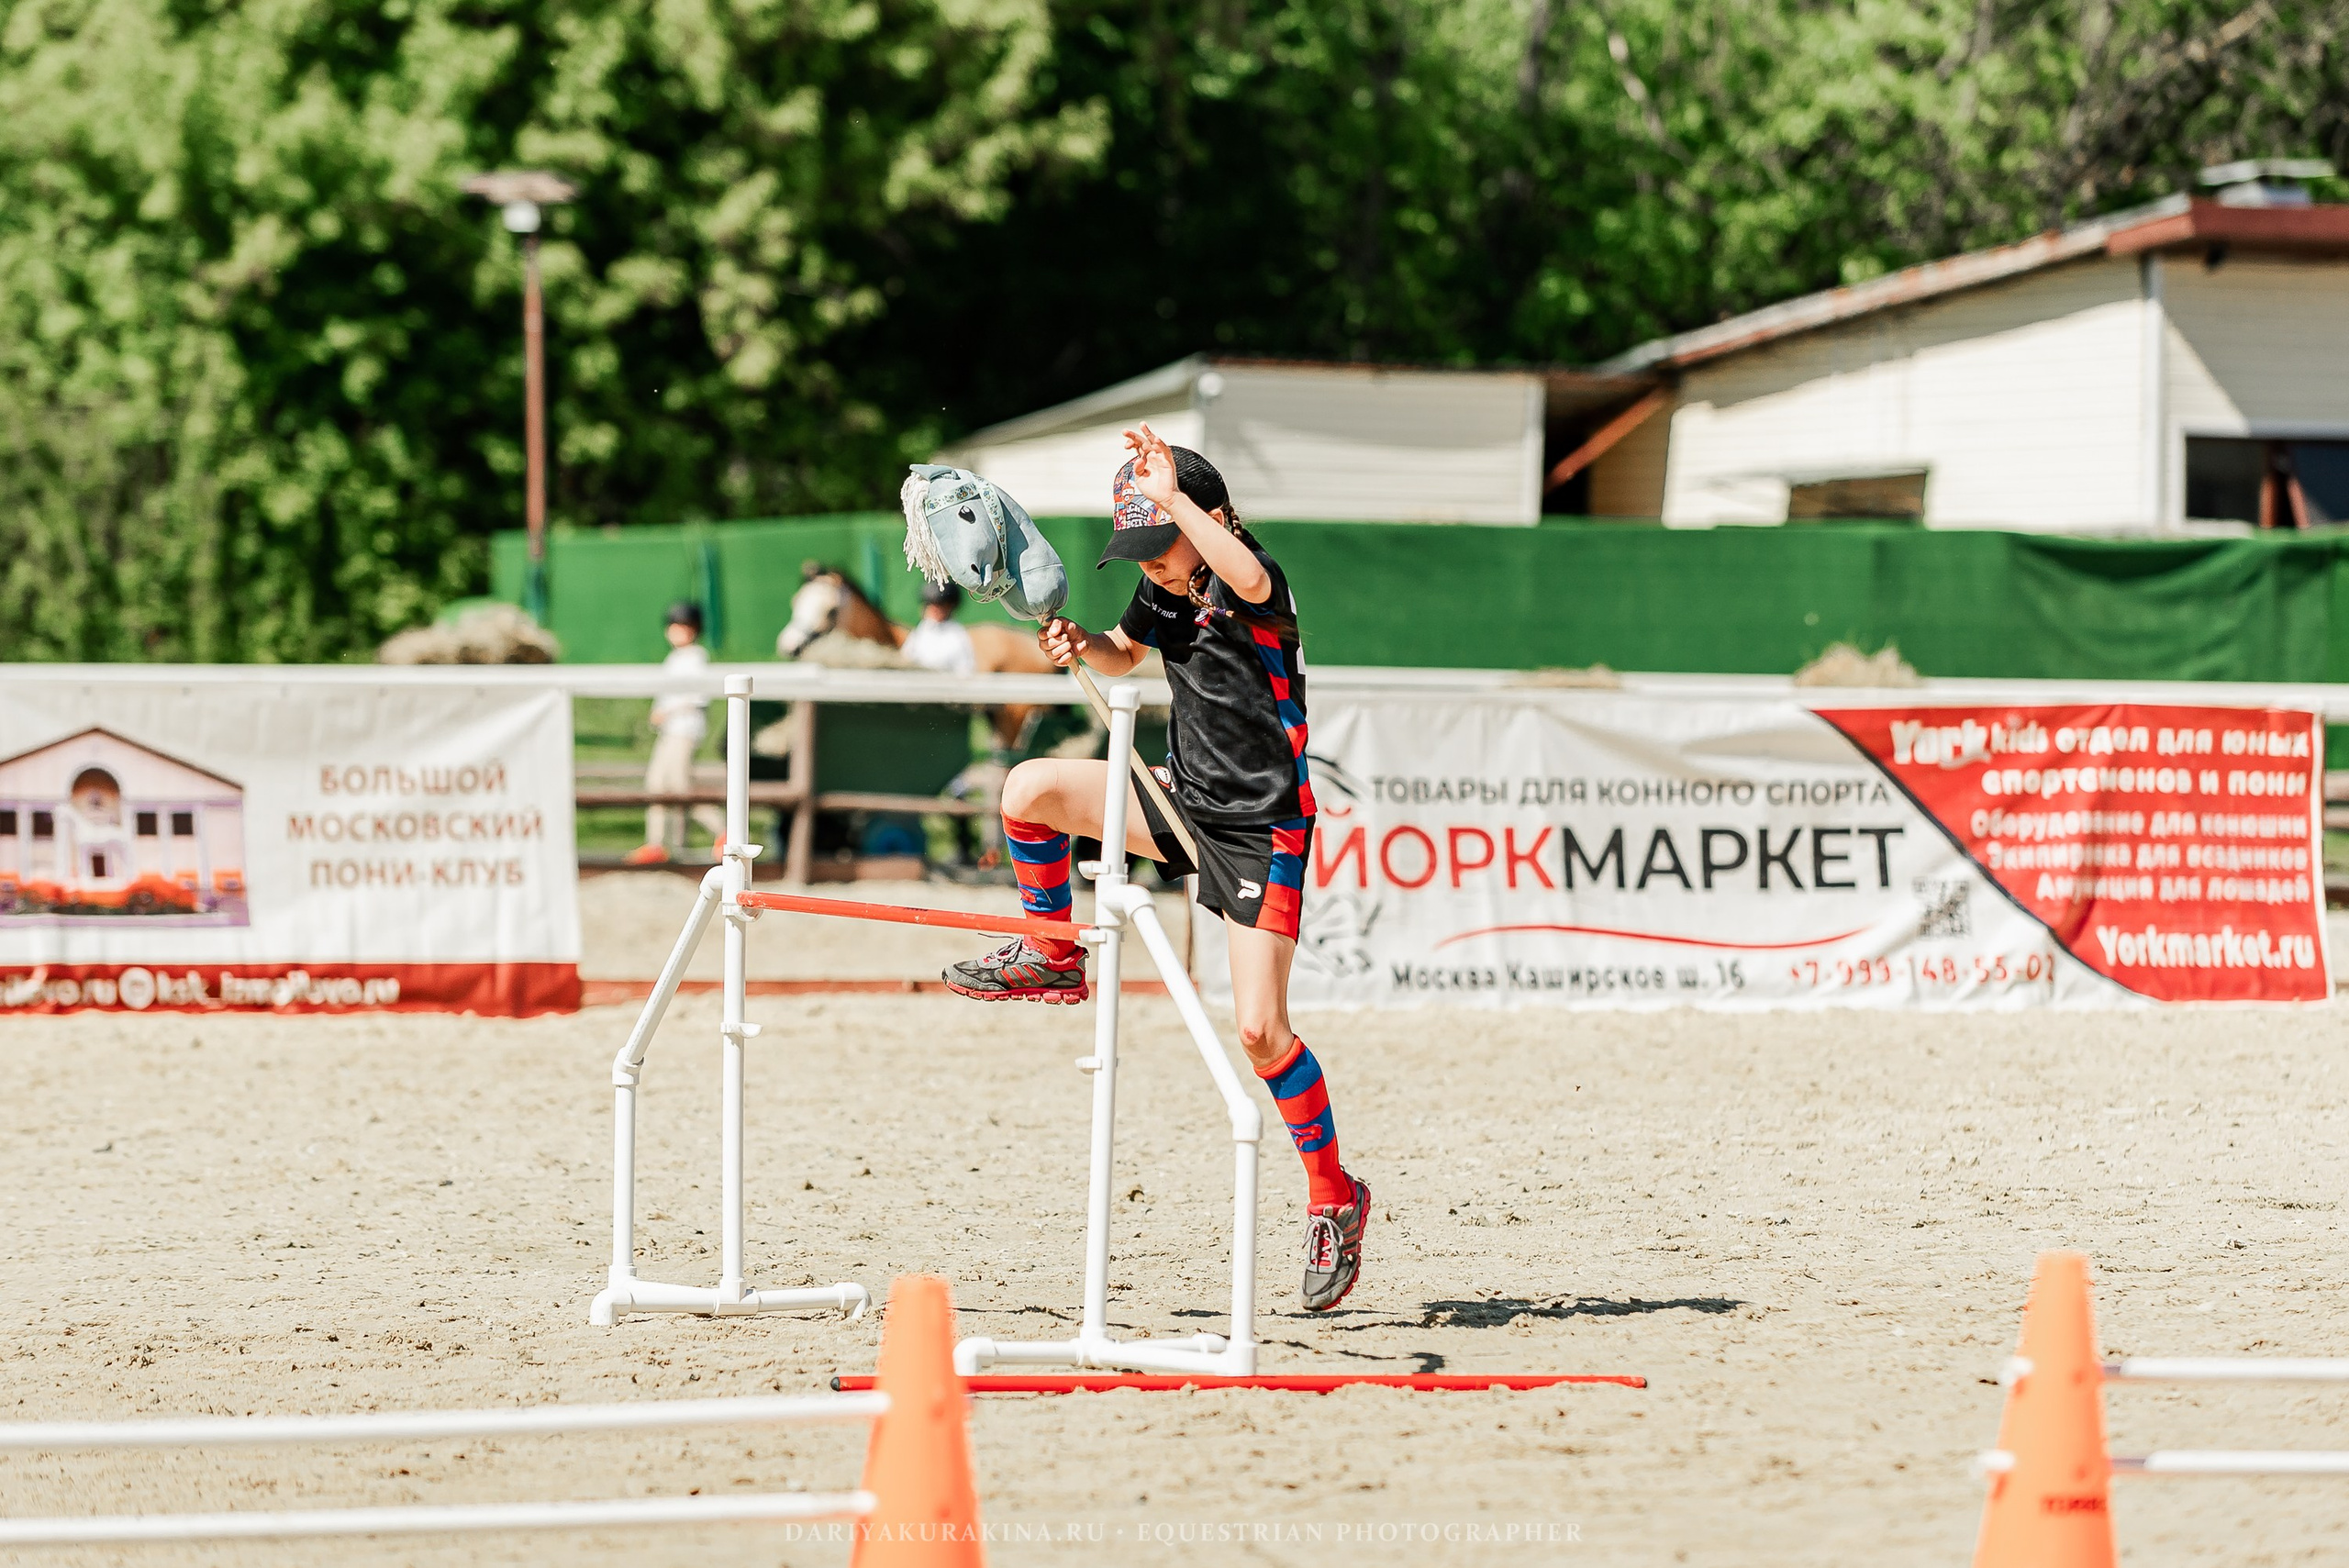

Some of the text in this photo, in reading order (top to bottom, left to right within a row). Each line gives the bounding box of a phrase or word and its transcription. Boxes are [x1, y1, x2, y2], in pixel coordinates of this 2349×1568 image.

[1991, 720, 2049, 754] kids
[2054, 727, 2149, 755] отдел
[2156, 728, 2212, 756] для
[2221, 728, 2310, 758] юных
[320, 758, 507, 795] БОЛЬШОЙ
[1373, 778, 1890, 807] ТОВАРЫ ДЛЯ КОННОГО СПОРТА
[1981, 768, 2307, 799] спортсменов и пони
[288, 805, 543, 841] МОСКОВСКИЙ
[2149, 811, 2197, 838] для
[1314, 805, 1904, 889] ЙОРКМАРКЕТ
[2136, 843, 2180, 870] для
[310, 858, 524, 888] ПОНИ-КЛУБ
[2159, 875, 2200, 902] для
[2096, 924, 2315, 969] Yorkmarket.ru
[1391, 960, 1745, 995] Москва Каширское ш. 16
